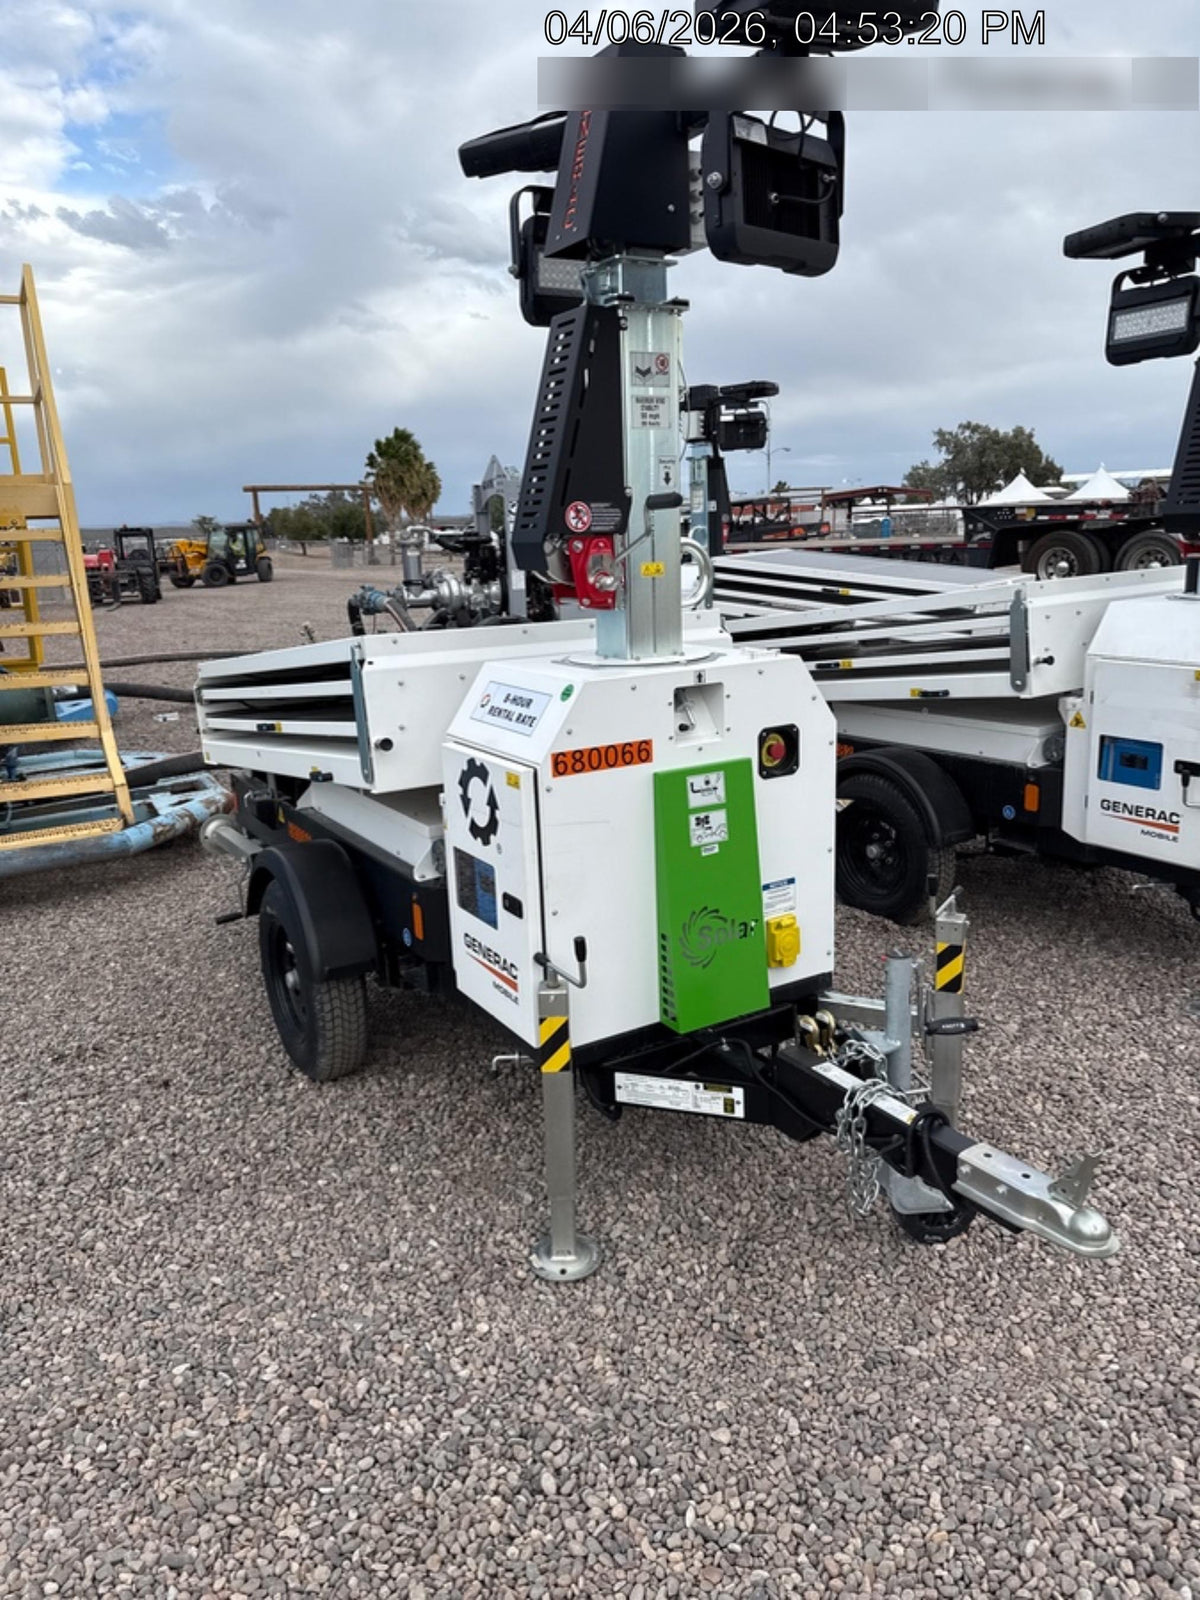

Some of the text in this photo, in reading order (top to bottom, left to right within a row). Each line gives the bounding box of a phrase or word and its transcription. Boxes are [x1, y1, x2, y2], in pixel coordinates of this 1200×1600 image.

[488, 705, 537, 728] RENTAL RATE
[554, 740, 650, 776] 680066
[1100, 798, 1181, 824] GENERAC
[1141, 829, 1179, 843] MOBILE
[698, 918, 759, 950] Solar
[463, 932, 519, 980] GENERAC
[492, 980, 519, 1006] MOBILE
